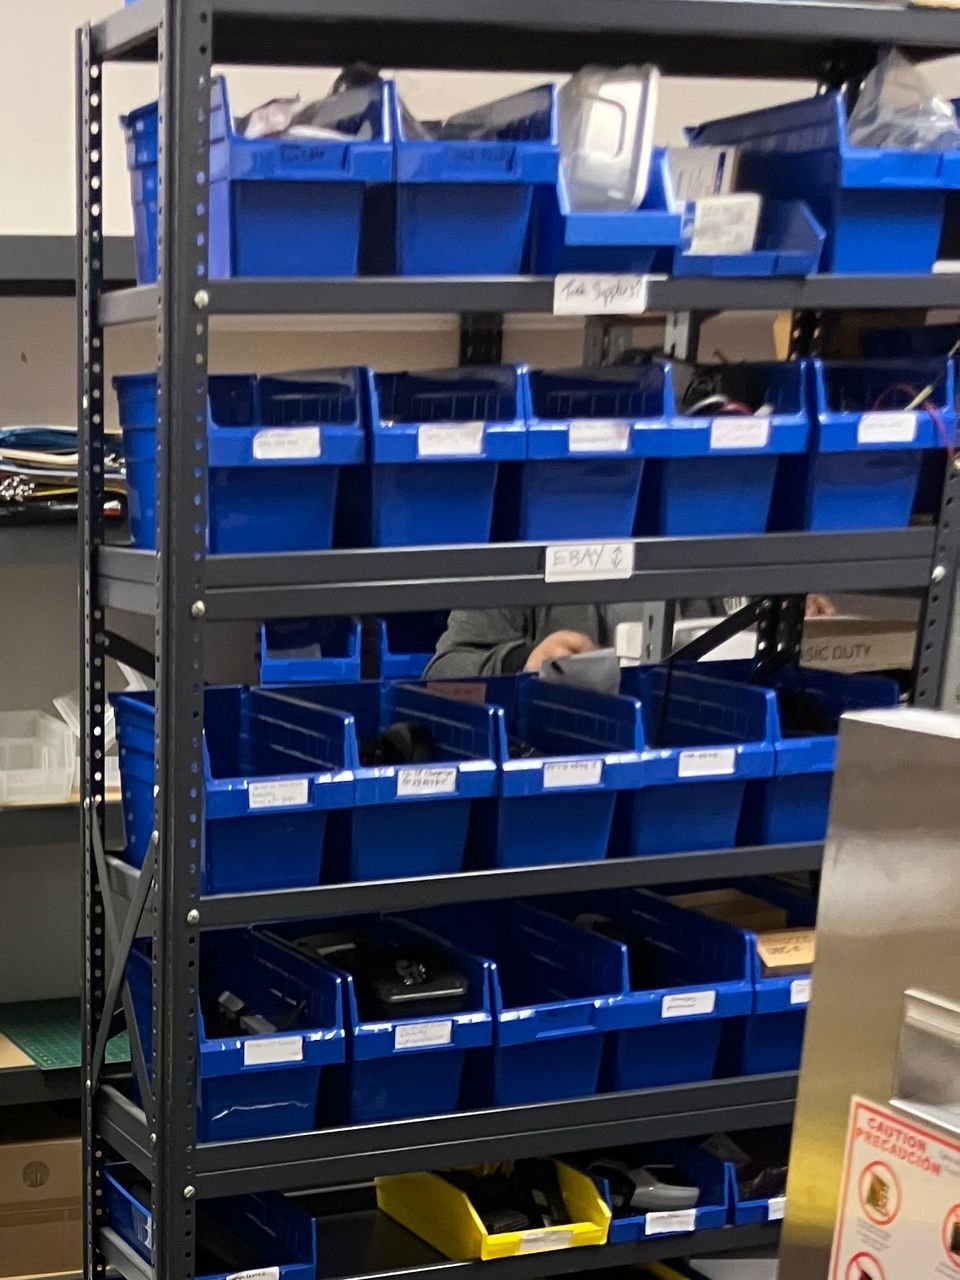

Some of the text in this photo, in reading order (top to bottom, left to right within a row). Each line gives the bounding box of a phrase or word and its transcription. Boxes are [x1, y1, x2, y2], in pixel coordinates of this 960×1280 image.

[553, 545, 605, 569] EBAY
[832, 644, 871, 660] DUTY
[867, 1118, 928, 1152] CAUTION
